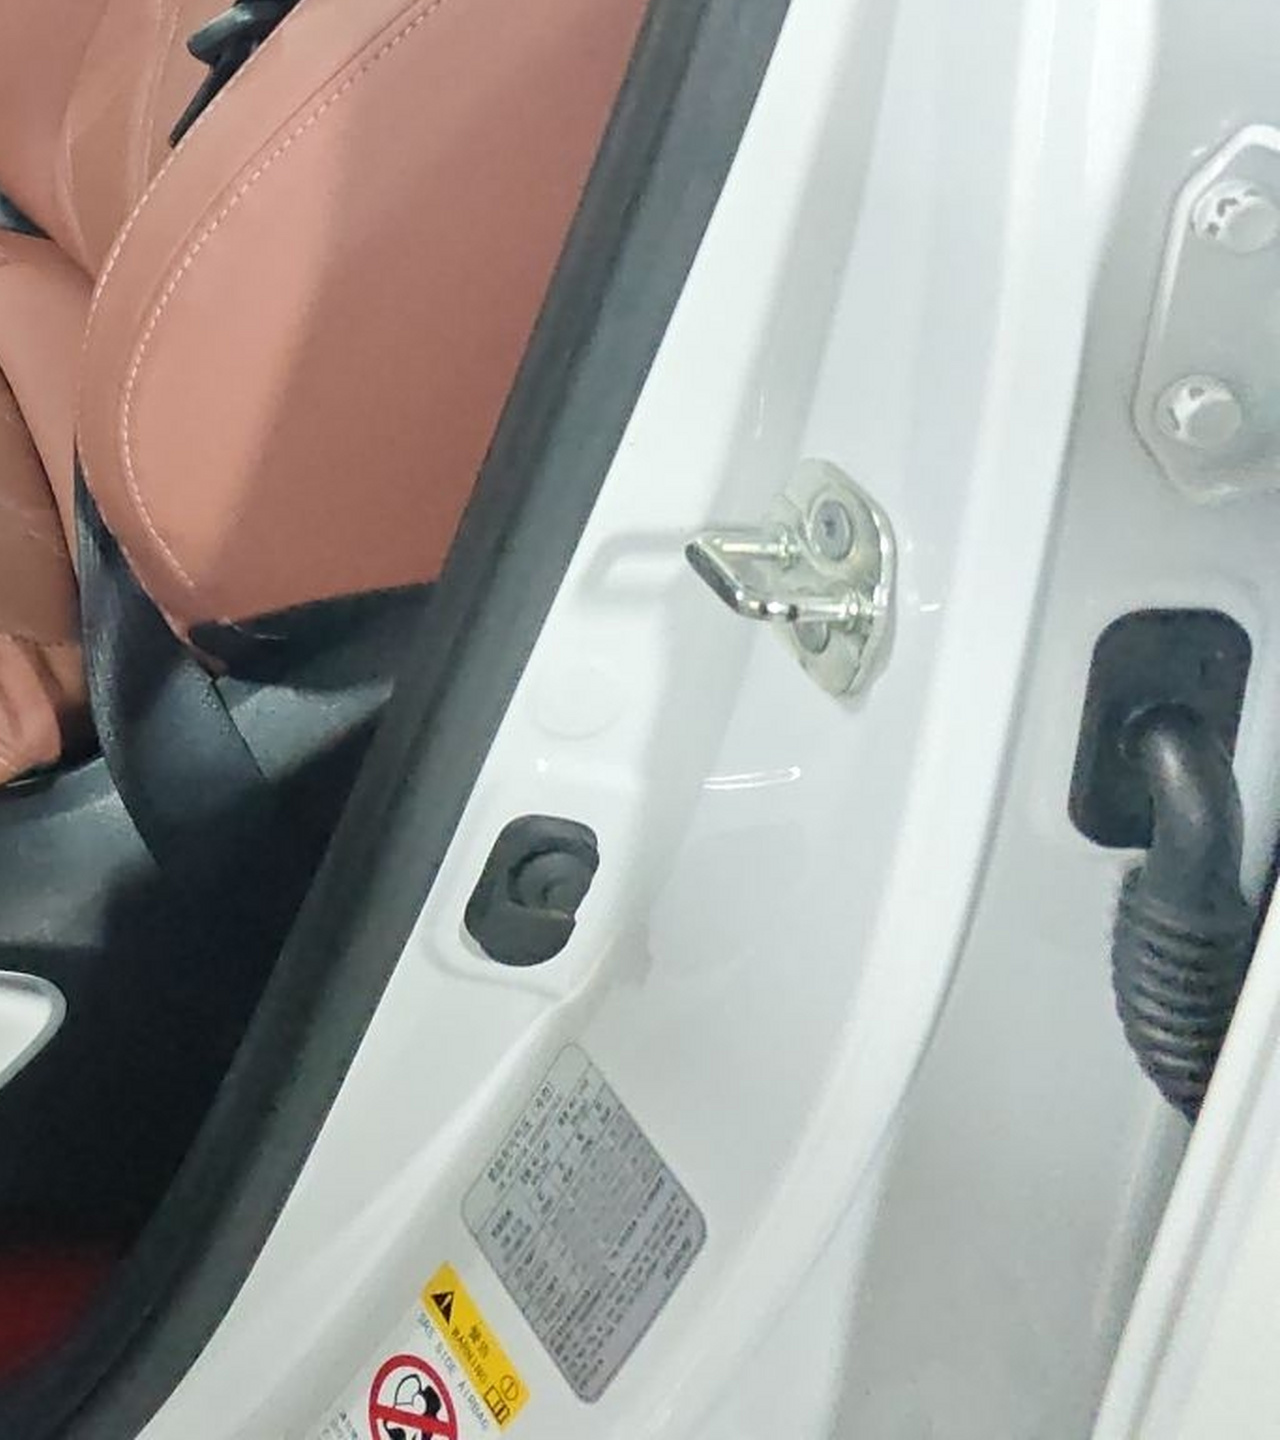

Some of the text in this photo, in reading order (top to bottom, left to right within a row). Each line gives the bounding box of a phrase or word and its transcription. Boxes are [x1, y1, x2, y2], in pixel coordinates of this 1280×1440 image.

[437, 1343, 456, 1374] SIDE
[458, 1381, 489, 1428] AIRBAG
[452, 1329, 488, 1383] WARNING
